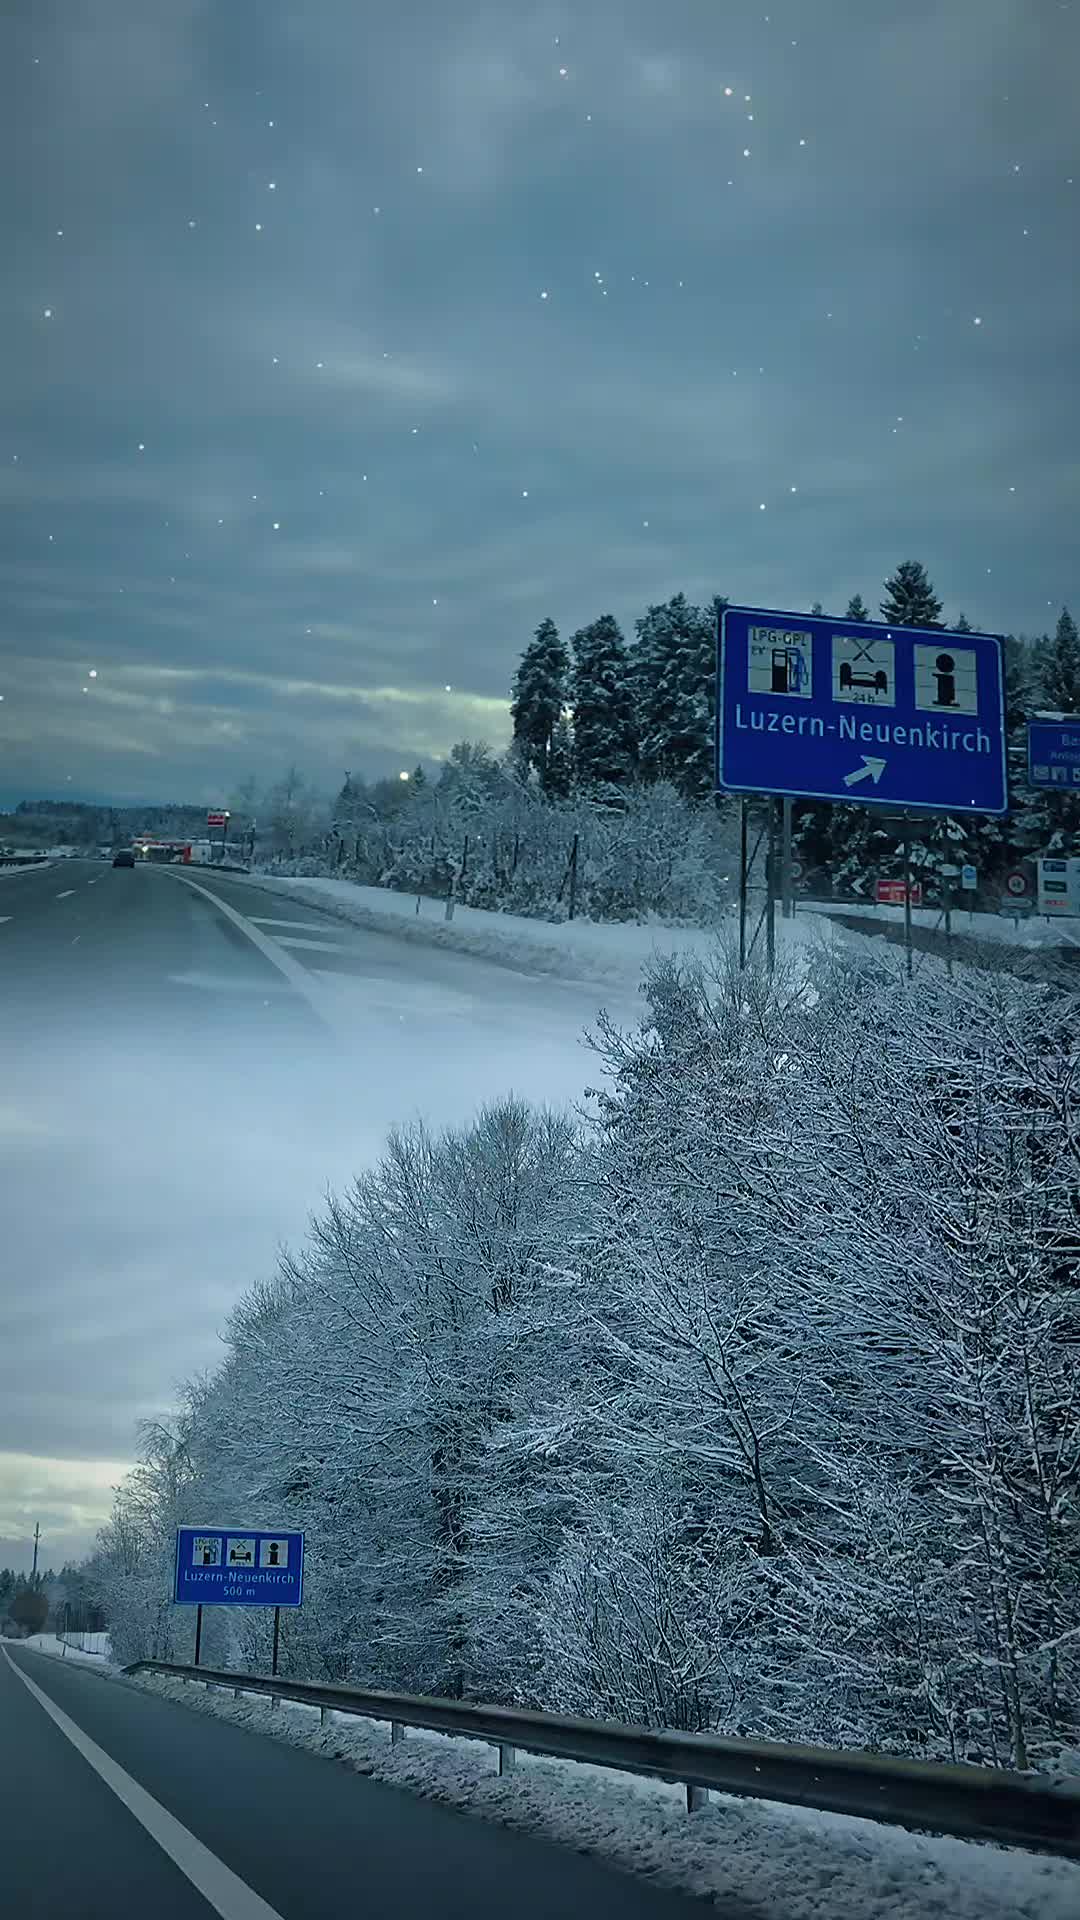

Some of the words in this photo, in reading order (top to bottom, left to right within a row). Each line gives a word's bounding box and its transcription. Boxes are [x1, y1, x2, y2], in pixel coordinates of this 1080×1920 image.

[752, 627, 807, 647] LPG-GPL
[736, 704, 991, 754] Luzern-Neuenkirch
[184, 1569, 294, 1584] Luzern-Neuenkirch
[223, 1586, 242, 1596] 500
[246, 1588, 255, 1596] m
